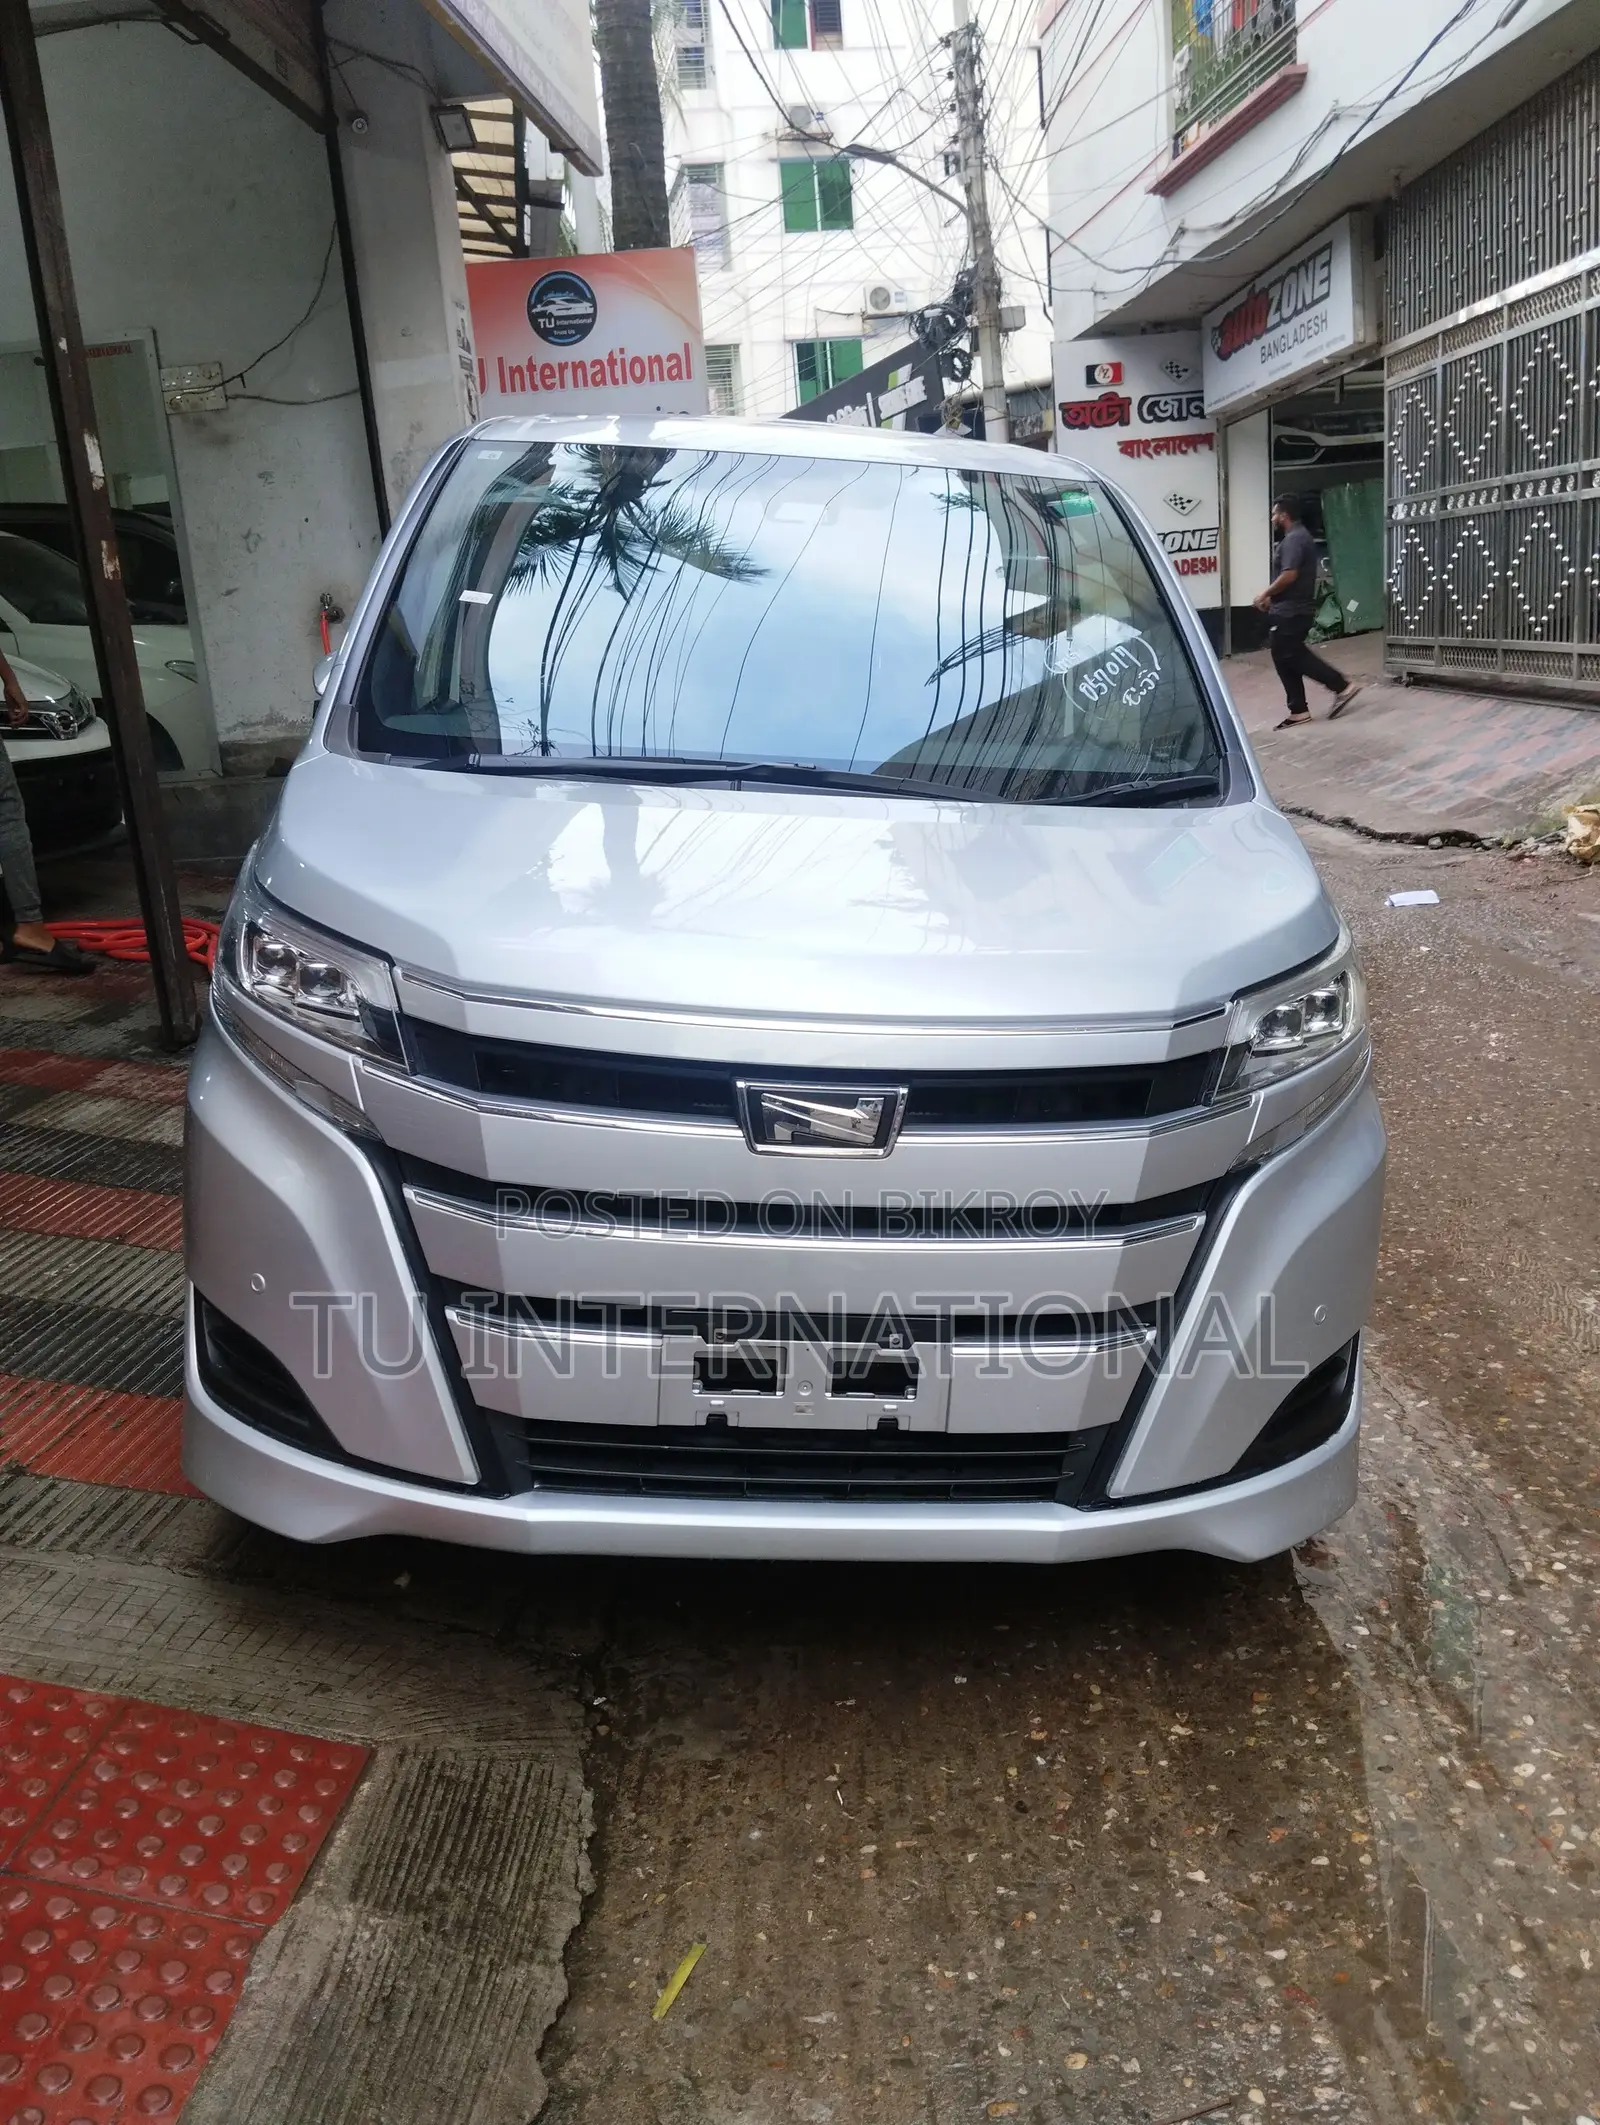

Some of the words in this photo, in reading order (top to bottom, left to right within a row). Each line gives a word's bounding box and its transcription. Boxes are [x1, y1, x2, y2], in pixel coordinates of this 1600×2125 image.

[538, 317, 555, 328] TU
[1260, 309, 1328, 364] BANGLADESH
[497, 342, 693, 394] International
[1059, 391, 1132, 430] অটো
[1117, 433, 1214, 459] বাংলাদেশ
